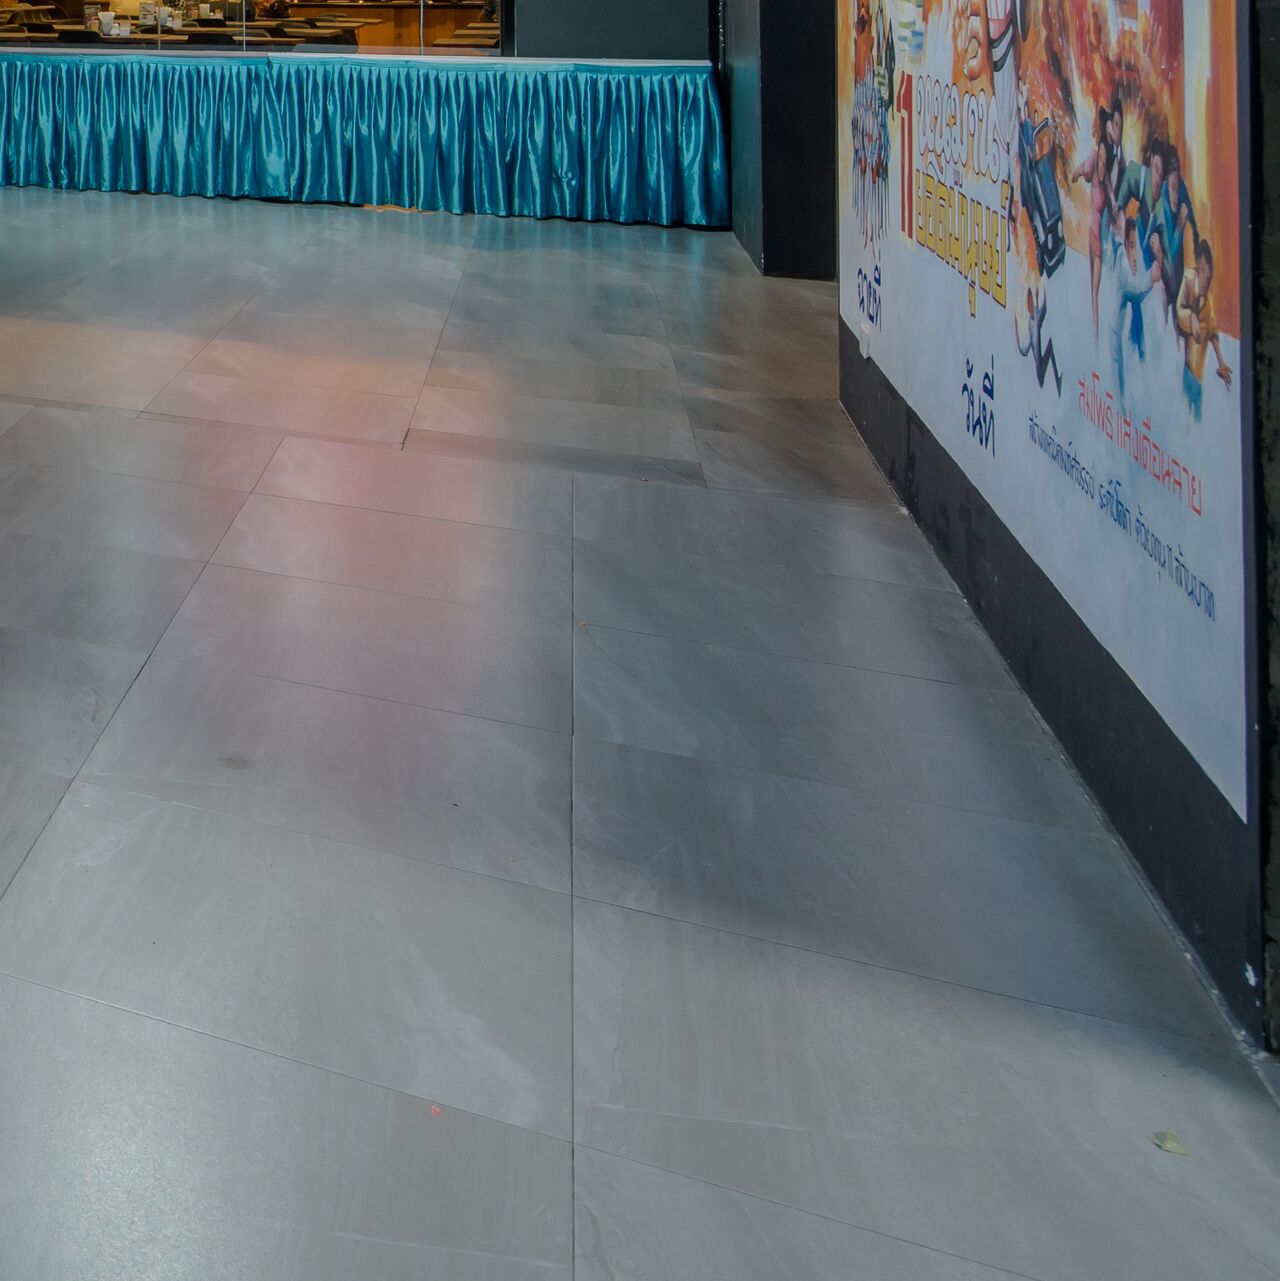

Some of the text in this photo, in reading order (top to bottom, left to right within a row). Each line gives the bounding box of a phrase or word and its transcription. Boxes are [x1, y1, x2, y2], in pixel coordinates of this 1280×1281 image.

[915, 75, 1006, 183] หนุมาน
[857, 250, 882, 332] ฉายที่
[915, 179, 1009, 318] ยอดมนุษย์
[961, 354, 996, 457] วันที่
